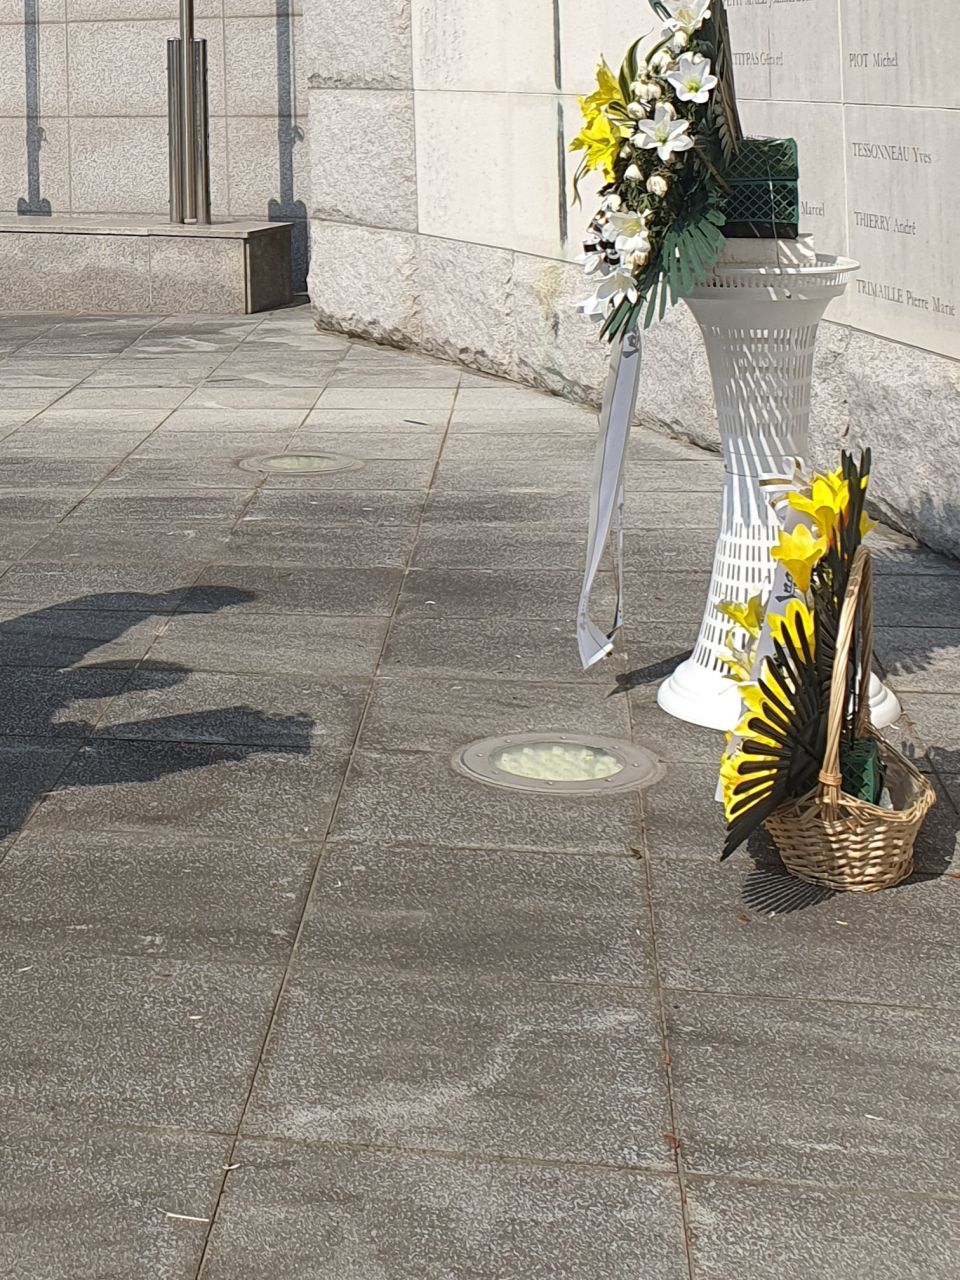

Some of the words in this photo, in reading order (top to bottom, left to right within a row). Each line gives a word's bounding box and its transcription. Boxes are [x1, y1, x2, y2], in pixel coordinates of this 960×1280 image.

[849, 52, 869, 68] PIOT
[872, 51, 898, 68] Michel
[852, 142, 909, 161] TESSONNEAU
[912, 147, 932, 163] Yves
[801, 201, 825, 217] Marcel
[854, 211, 890, 232] THIERRY
[893, 218, 917, 235] André
[856, 279, 904, 304] TRIMAILLE
[906, 289, 929, 310] Pierre
[932, 295, 956, 317] Marie
